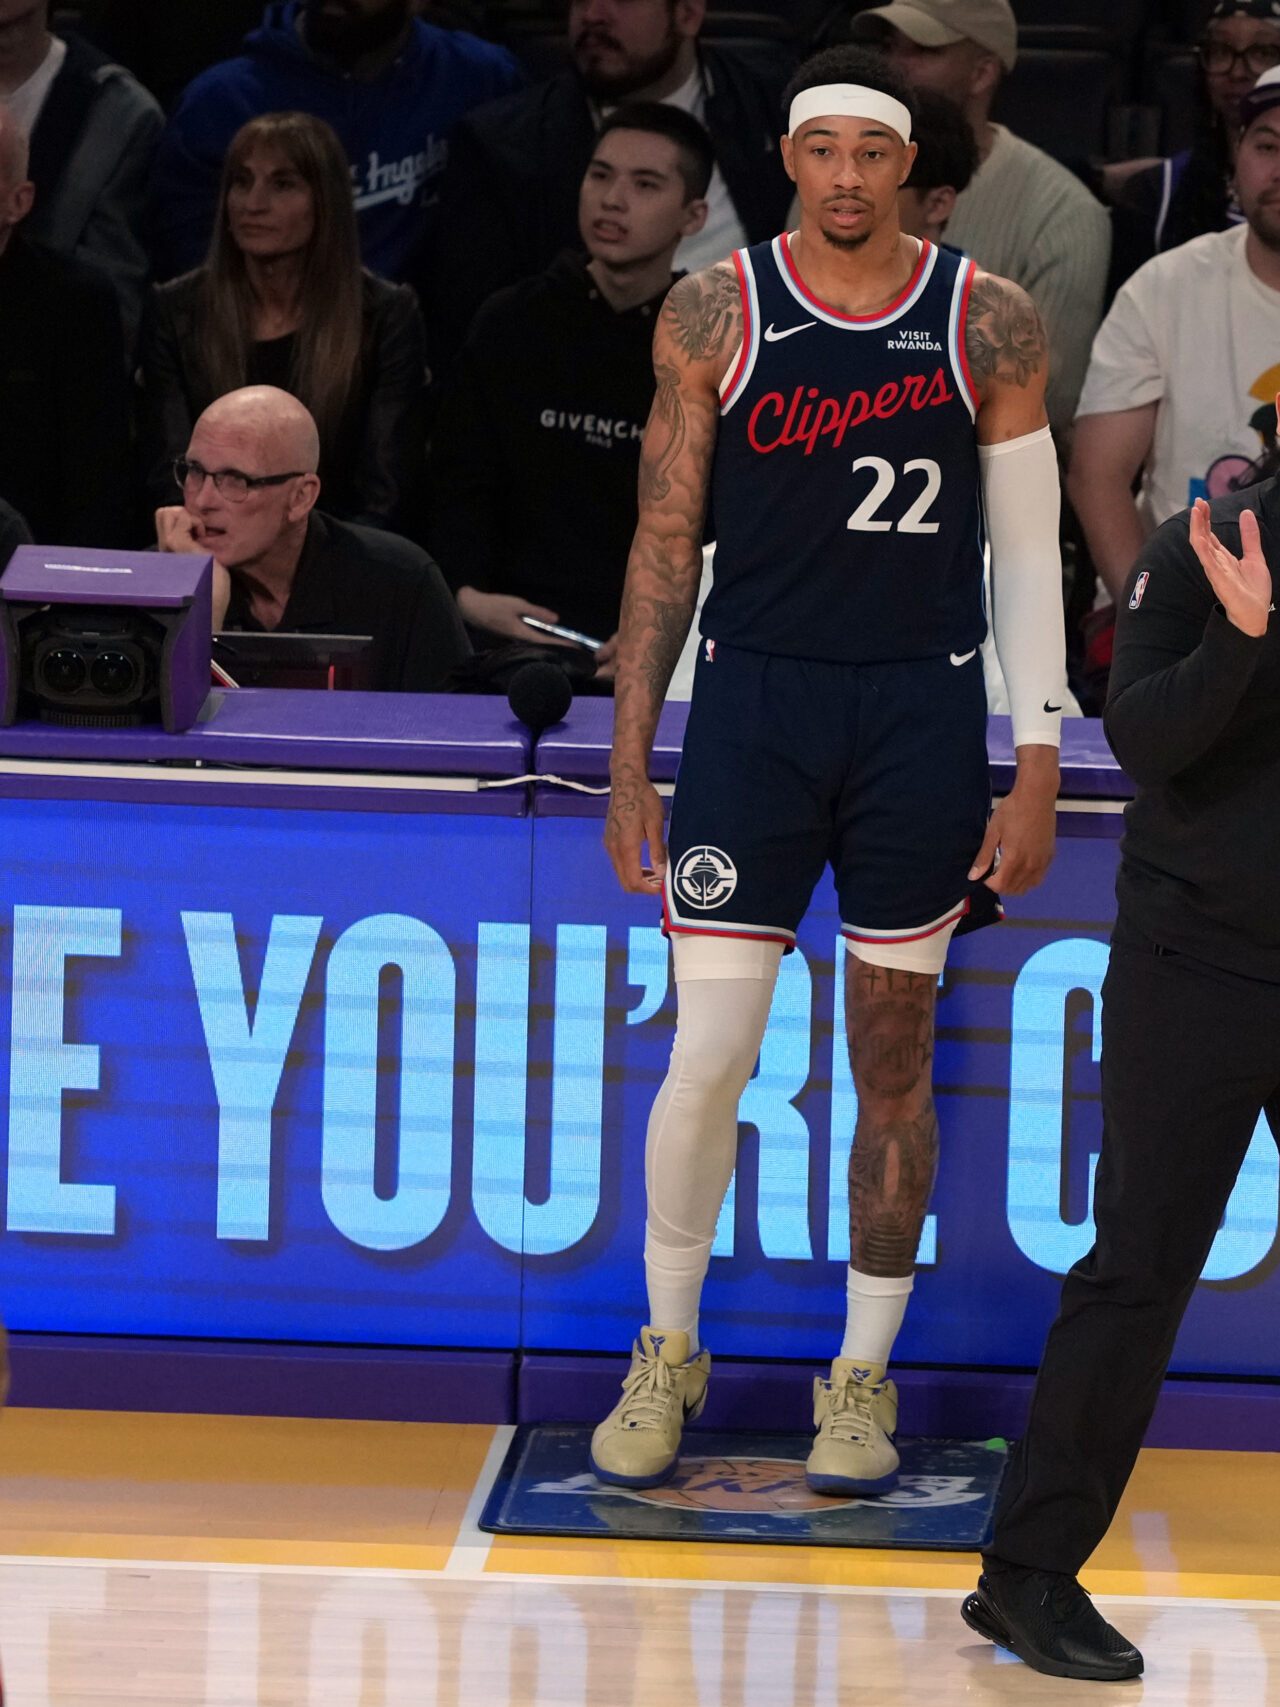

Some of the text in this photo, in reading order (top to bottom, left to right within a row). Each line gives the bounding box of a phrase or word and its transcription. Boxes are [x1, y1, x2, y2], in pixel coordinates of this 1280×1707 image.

[887, 340, 943, 352] RWANDA
[899, 330, 931, 341] VISIT
[540, 408, 646, 441] GIVENCH
[747, 367, 953, 456] Clippers
[846, 455, 942, 534] 22
